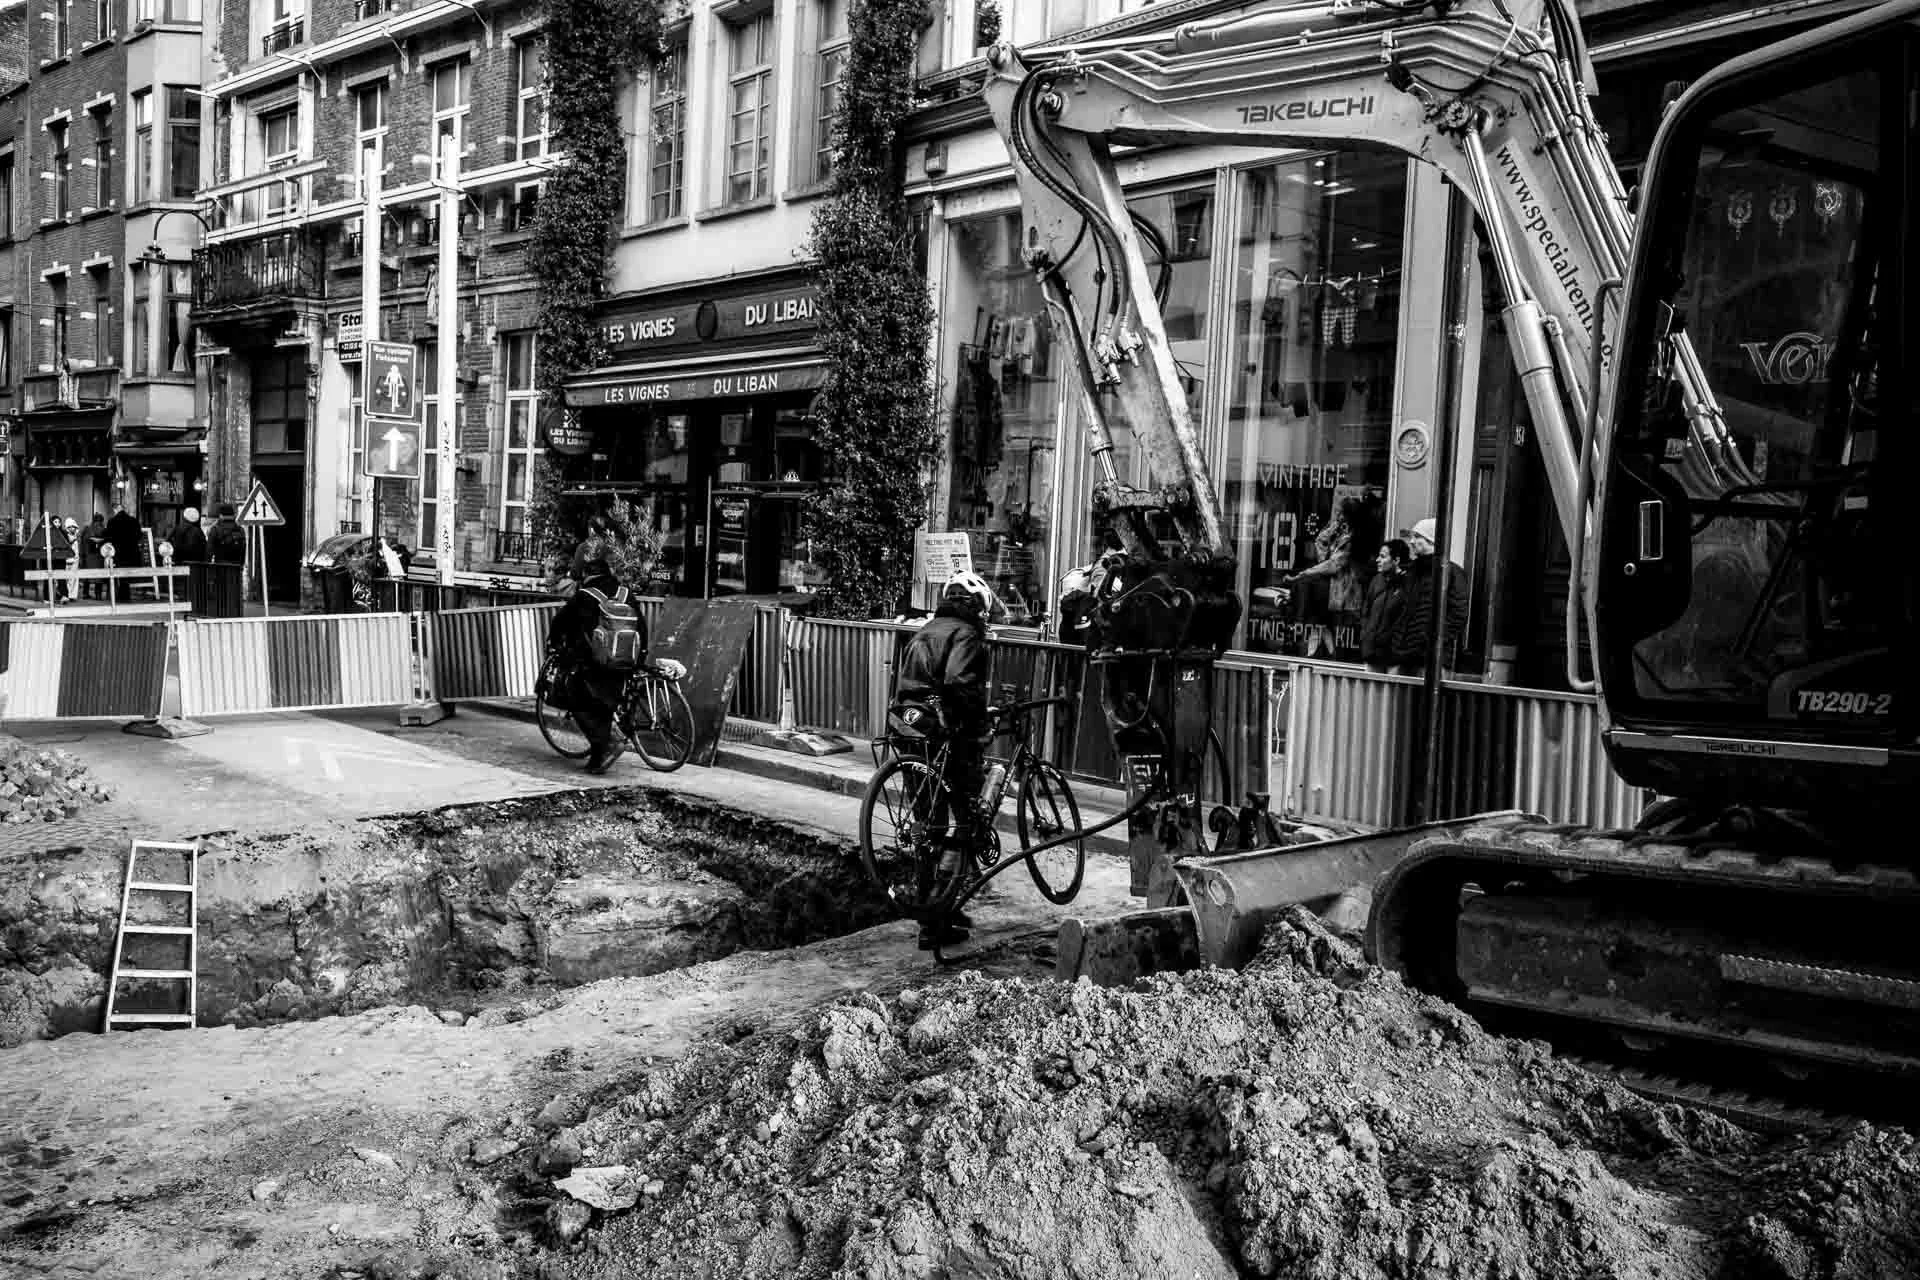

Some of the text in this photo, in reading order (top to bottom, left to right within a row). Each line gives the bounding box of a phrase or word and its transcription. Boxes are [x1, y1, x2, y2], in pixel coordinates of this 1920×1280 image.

[1236, 96, 1373, 124] TAKEUCHI
[745, 303, 768, 326] DU
[630, 317, 676, 341] VIGNES
[604, 373, 778, 403] LES VIGNES DU LIBAN
[1259, 463, 1348, 489] VINTAGE
[1293, 623, 1327, 643] POT
[1335, 625, 1360, 649] KIL
[1798, 690, 1892, 714] TB290-2
